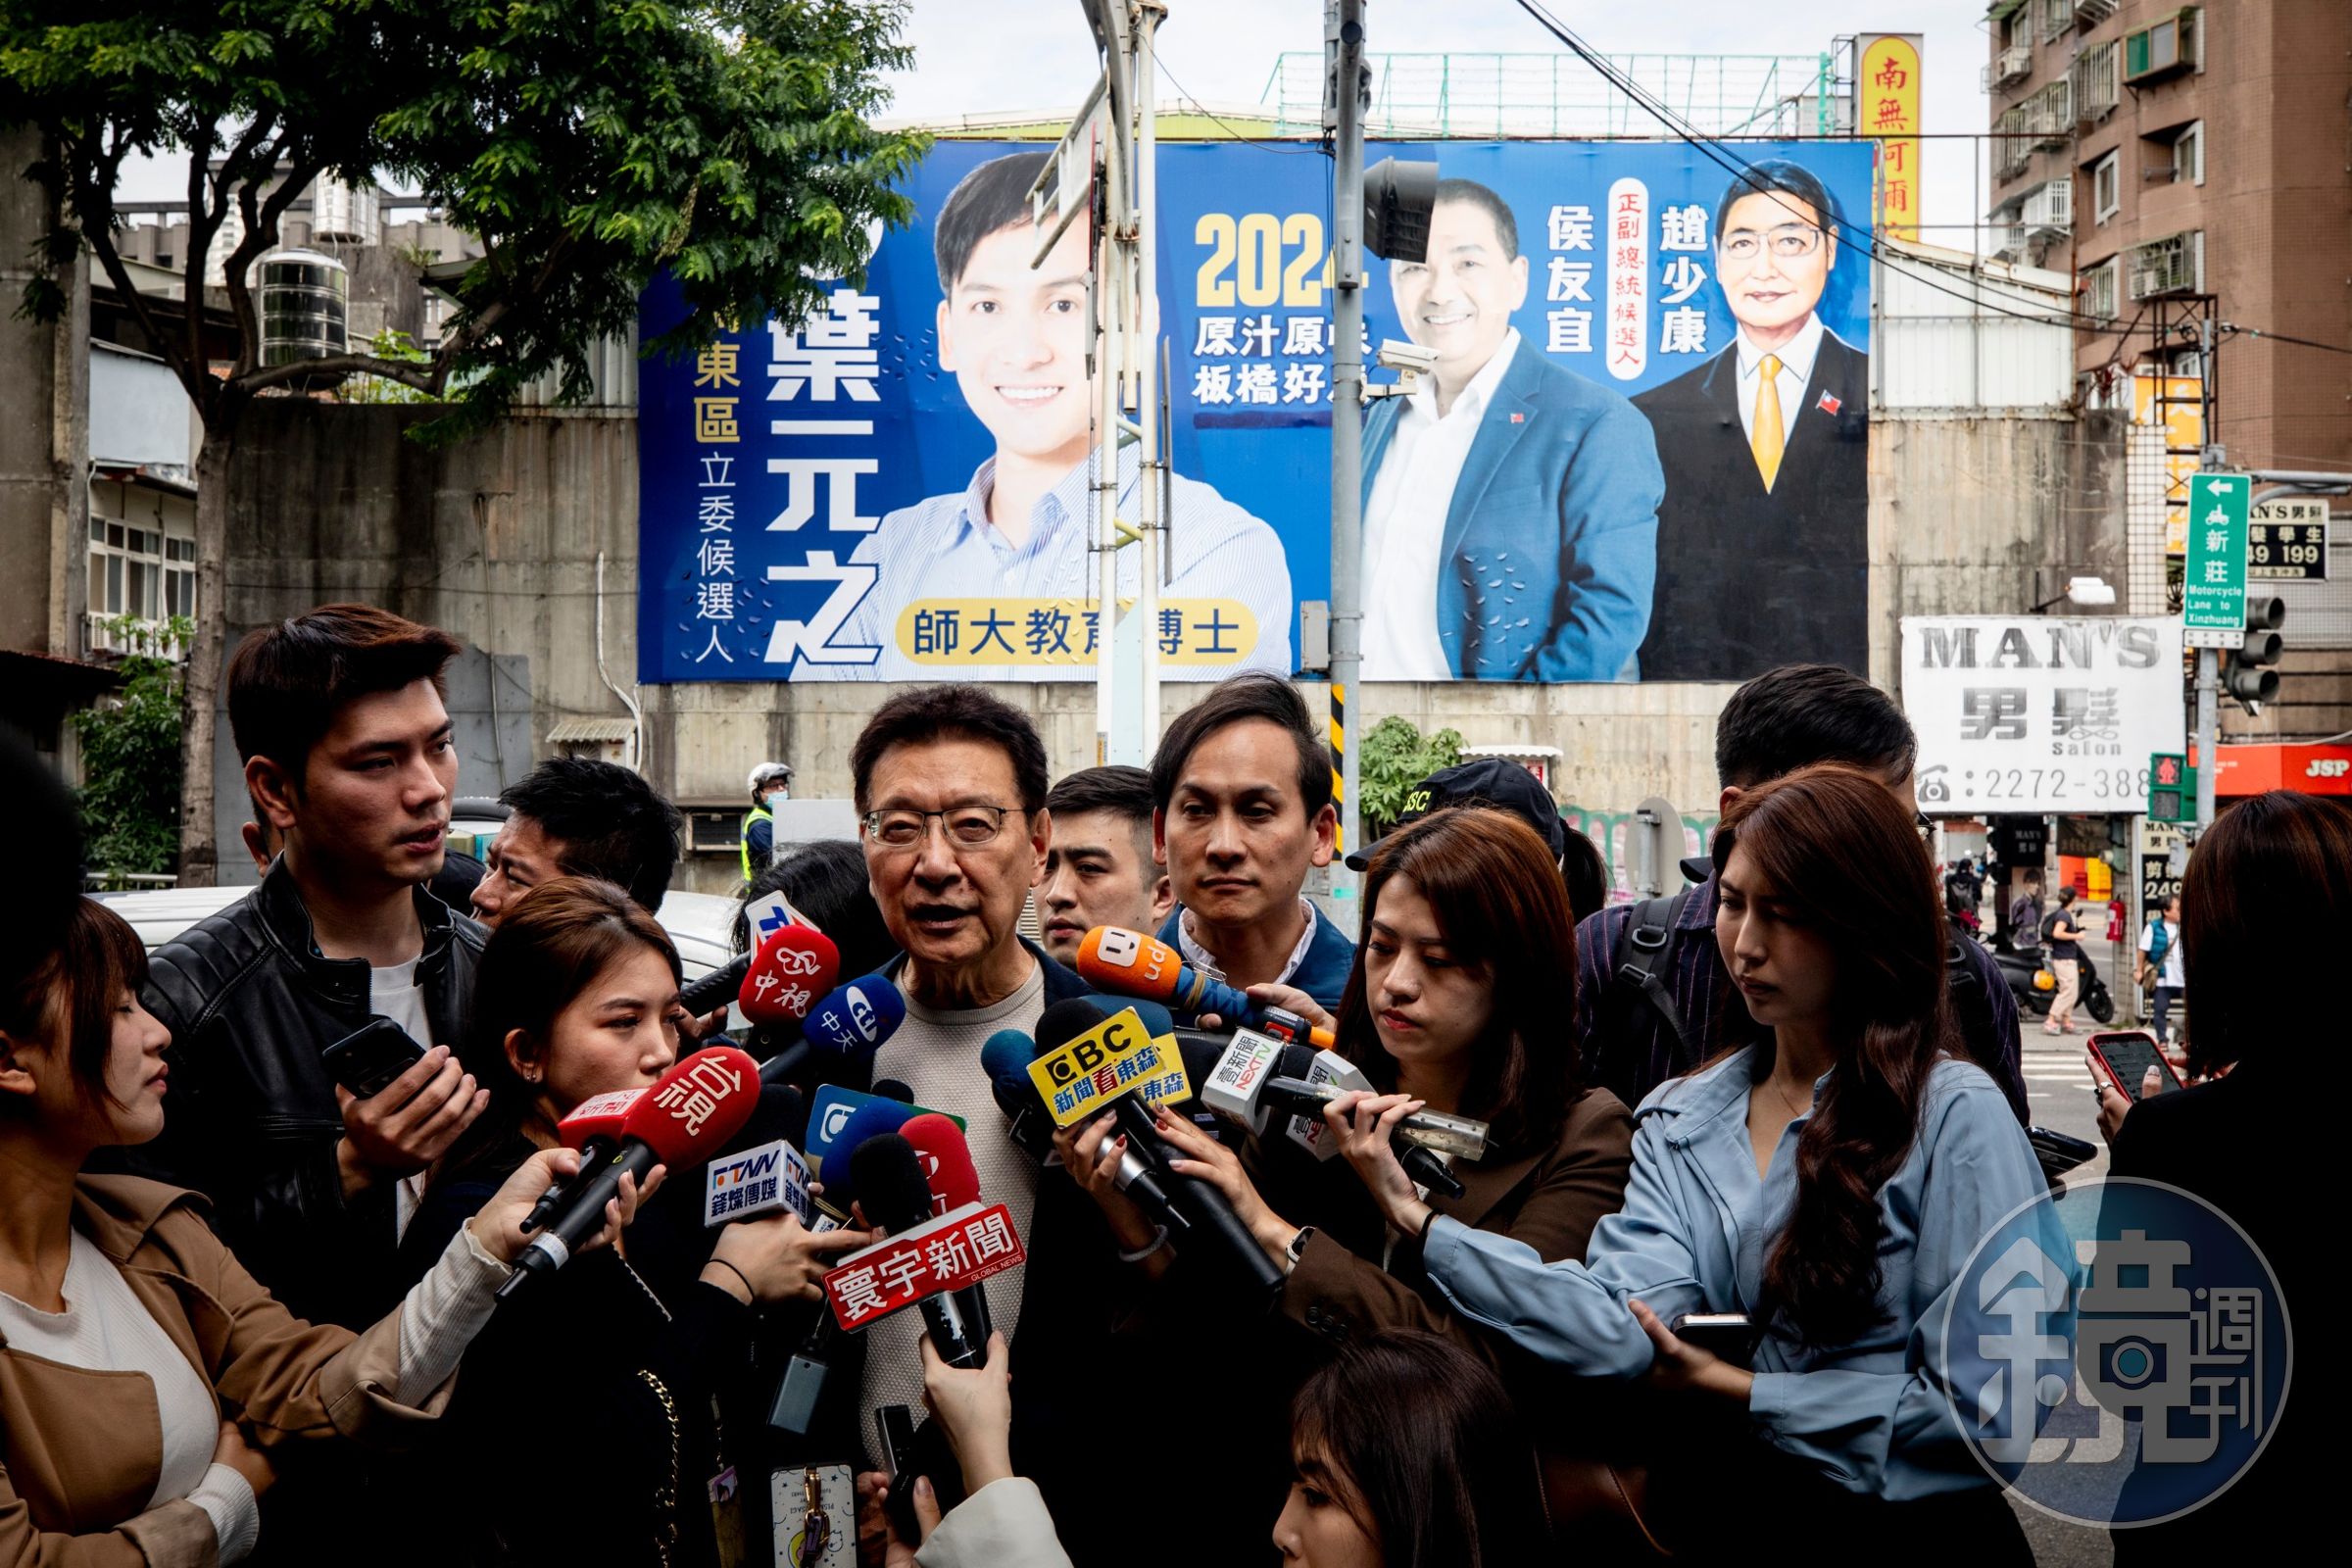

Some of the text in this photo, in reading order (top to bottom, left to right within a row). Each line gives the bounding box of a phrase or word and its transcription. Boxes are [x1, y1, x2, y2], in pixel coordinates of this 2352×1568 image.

[1546, 205, 1594, 353] 侯友宜
[1614, 194, 1644, 365] 正副總統候選人
[1659, 204, 1709, 354] 趙少康
[1192, 363, 1370, 405] 板橋好
[763, 288, 882, 663] 葉元之
[2204, 529, 2229, 583] 新莊
[2282, 545, 2319, 564] 199
[2187, 600, 2230, 610] Lane to
[2188, 585, 2242, 598] Motorcycle
[2187, 613, 2240, 626] Xinzhuang
[1919, 625, 2161, 669] MAN'S
[2306, 760, 2350, 776] JSP
[755, 969, 811, 1018] 中視
[821, 1010, 858, 1054] 中天
[1053, 1045, 1157, 1115] 新聞看東森
[1216, 1035, 1259, 1087] 壹新聞
[653, 1055, 741, 1137] 台視
[1136, 1071, 1184, 1102] 東森
[710, 1177, 777, 1217] 鋒燦傳媒
[832, 1212, 1014, 1322] 寰宇新聞
[970, 1254, 1022, 1282] GLOBAL NEWS
